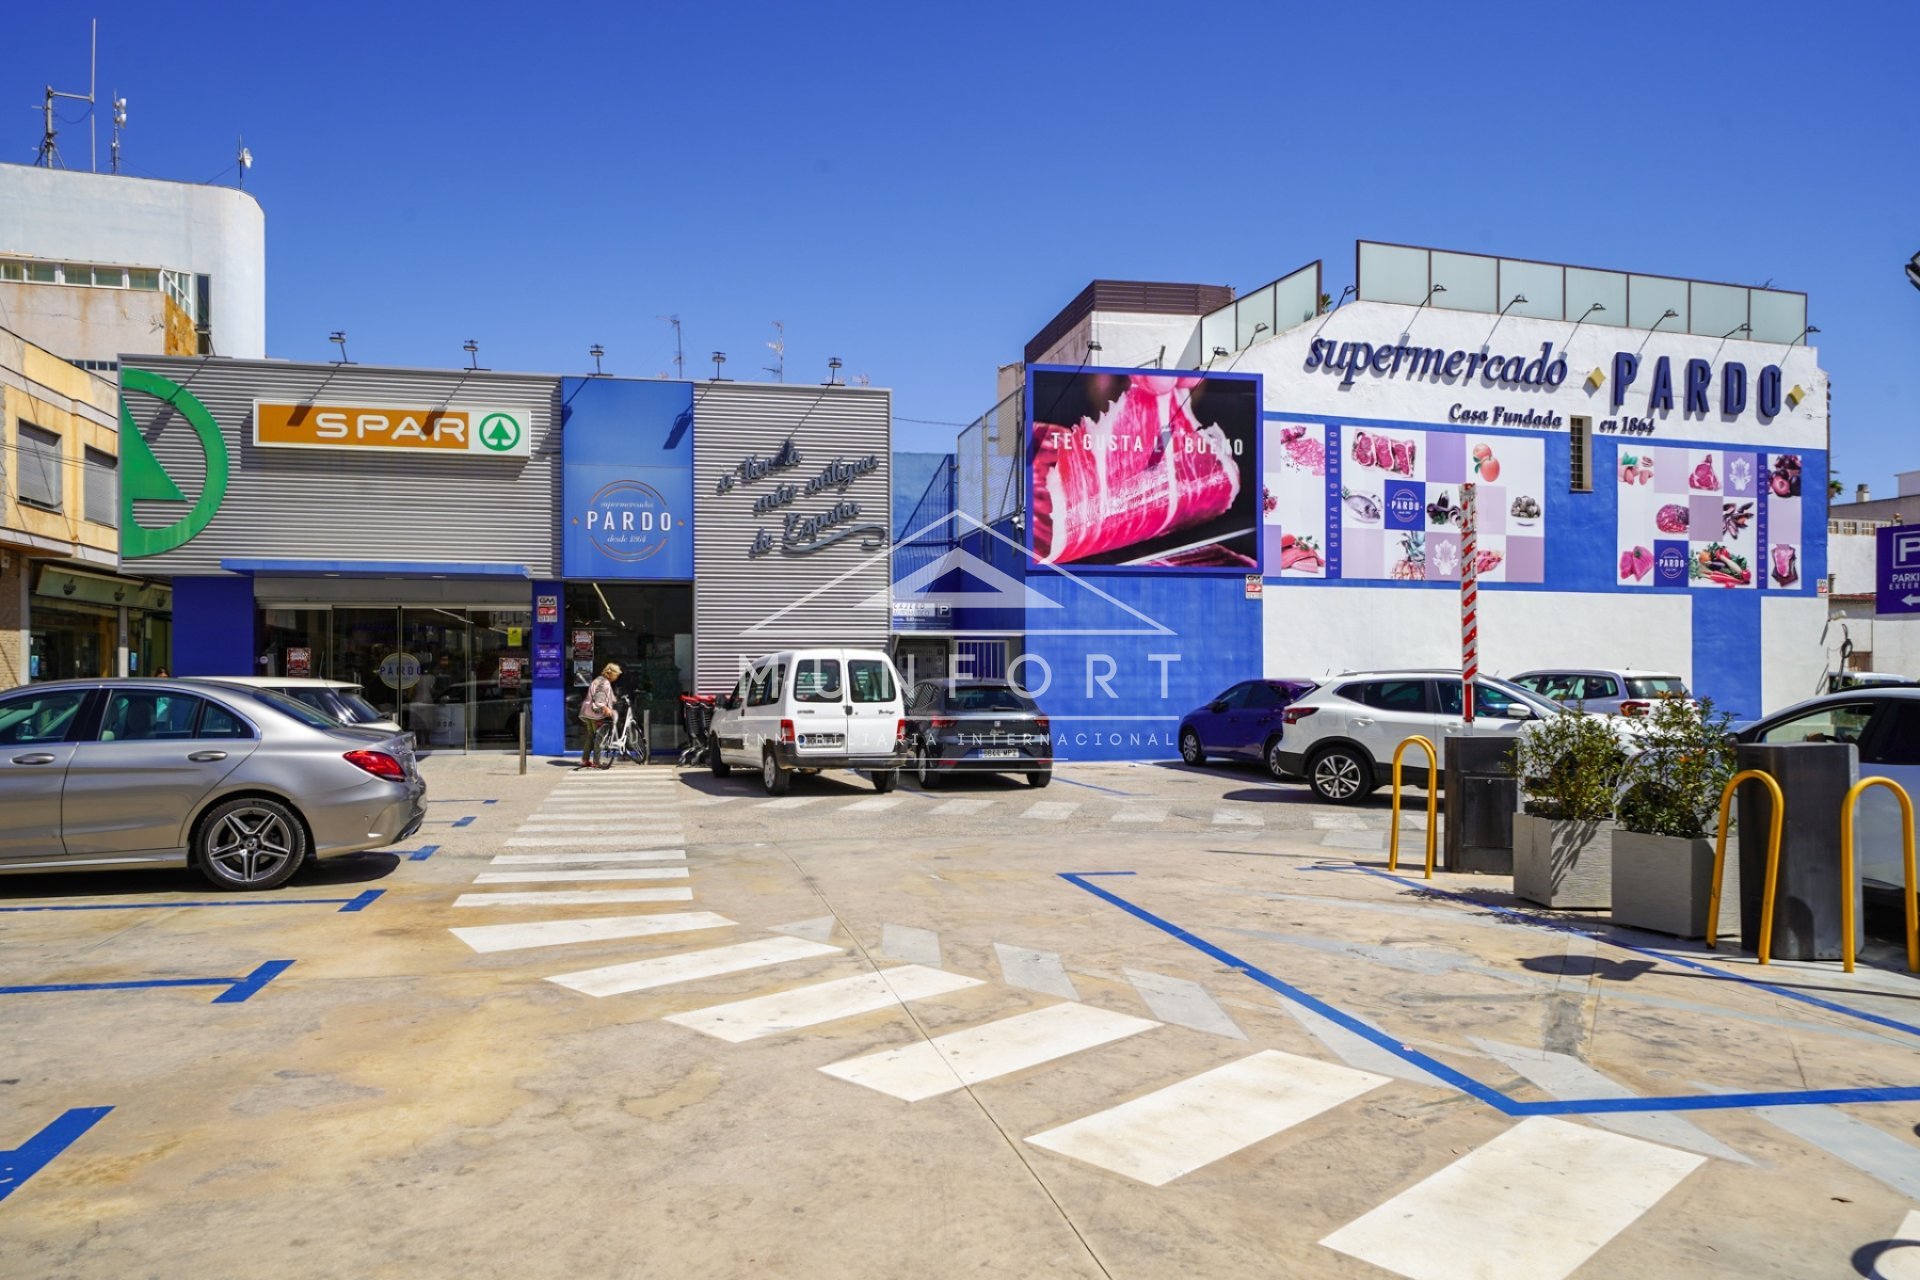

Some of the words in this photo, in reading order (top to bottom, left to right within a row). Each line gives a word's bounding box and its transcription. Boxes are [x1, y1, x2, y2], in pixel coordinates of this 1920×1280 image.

[1306, 337, 1568, 386] supermercado
[1614, 351, 1782, 418] PARDO
[1449, 403, 1488, 424] Casa
[1493, 406, 1562, 428] Fundada
[1600, 419, 1617, 433] en
[1621, 416, 1655, 434] 1864
[316, 413, 465, 442] SPAR
[1051, 432, 1072, 450] TE
[1330, 431, 1338, 474] BUENO
[804, 455, 880, 494] antigua
[1330, 482, 1338, 497] LO
[1391, 500, 1420, 511] PARDO
[1759, 502, 1765, 515] LO
[586, 511, 671, 531] PARDO
[1330, 506, 1338, 548] GUSTA
[1330, 557, 1338, 571] TE
